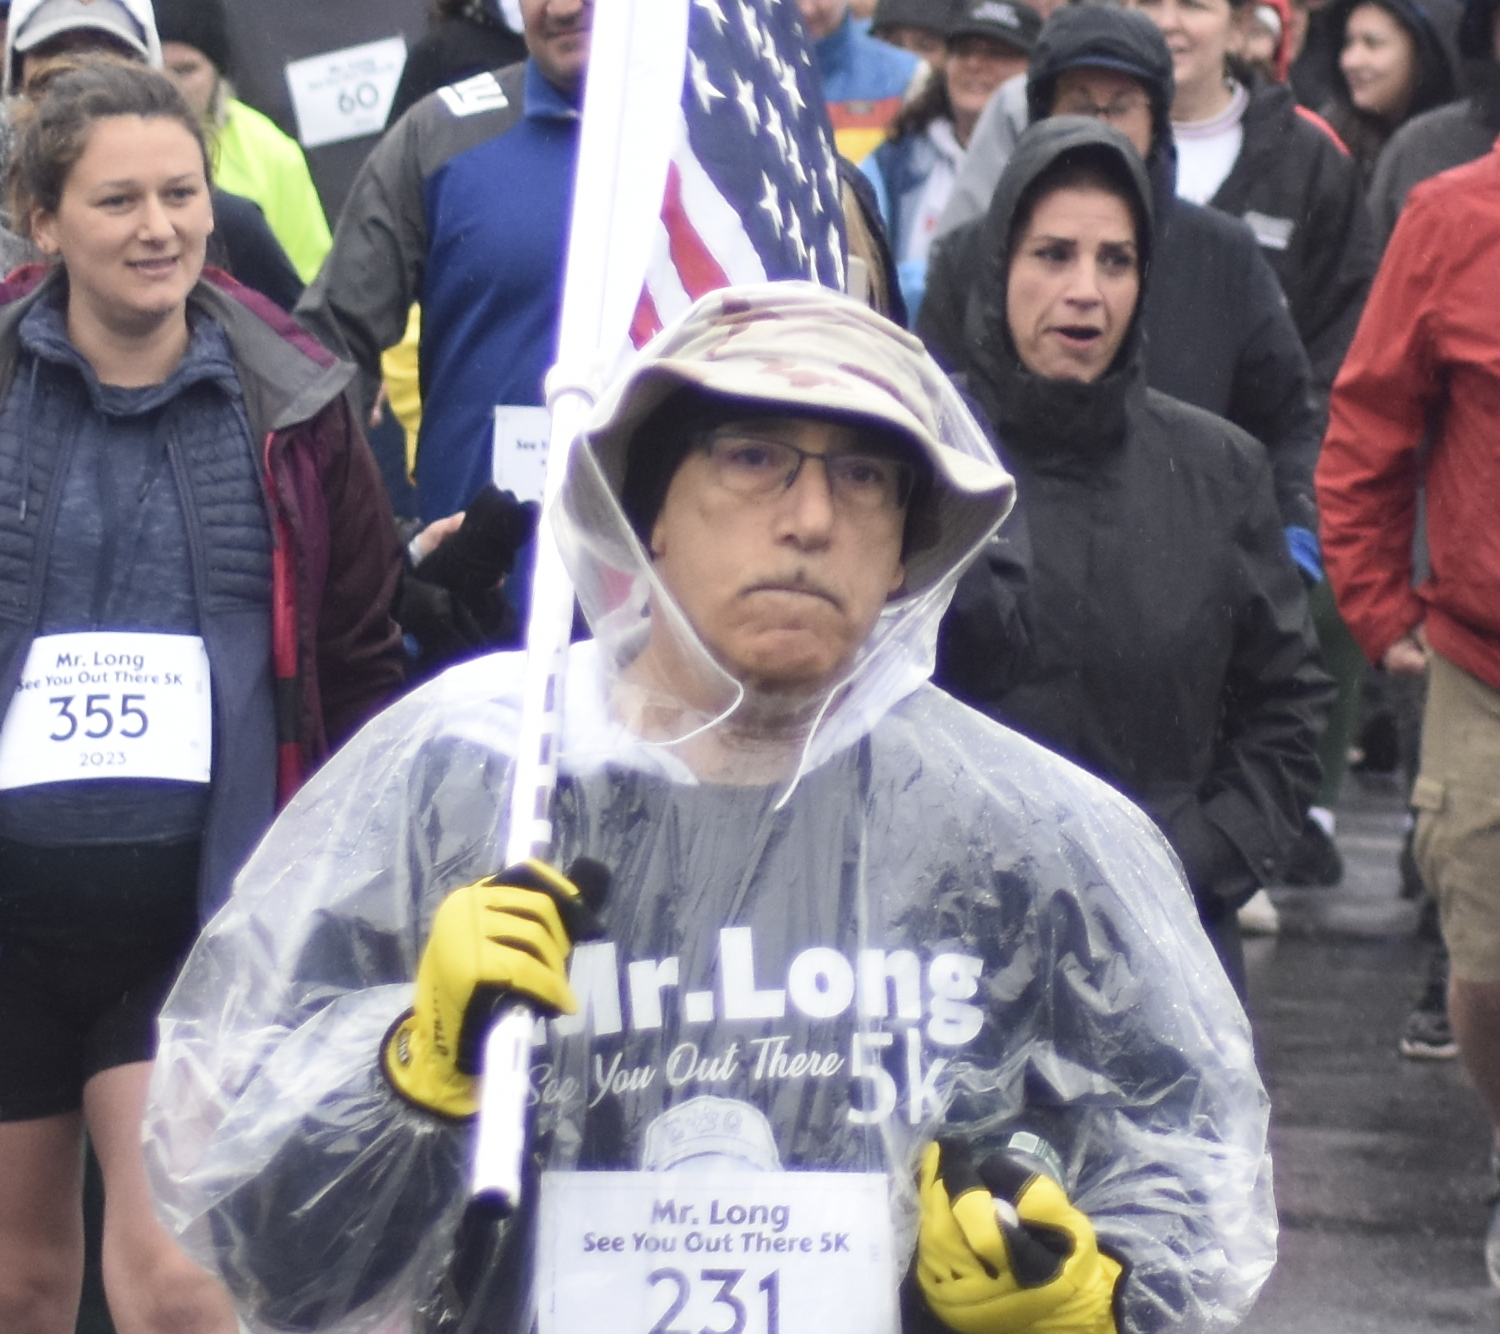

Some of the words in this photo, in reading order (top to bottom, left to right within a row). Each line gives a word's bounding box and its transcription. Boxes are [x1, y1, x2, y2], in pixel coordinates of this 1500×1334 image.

[338, 82, 380, 114] 60
[56, 652, 87, 668] Mr.
[93, 651, 145, 671] Long
[45, 674, 73, 686] You
[77, 670, 108, 684] Out
[114, 670, 159, 684] There
[164, 672, 184, 686] 5K
[49, 694, 149, 742] 355
[79, 752, 127, 768] 2023
[589, 1051, 657, 1108] You
[666, 1040, 741, 1086] Out
[749, 1035, 847, 1080] There
[650, 1199, 700, 1226] Mr.
[709, 1199, 791, 1233] Long
[583, 1232, 625, 1253] See
[632, 1232, 678, 1253] You
[684, 1231, 734, 1253] Out
[741, 1231, 813, 1253] There
[819, 1231, 851, 1253] 5K
